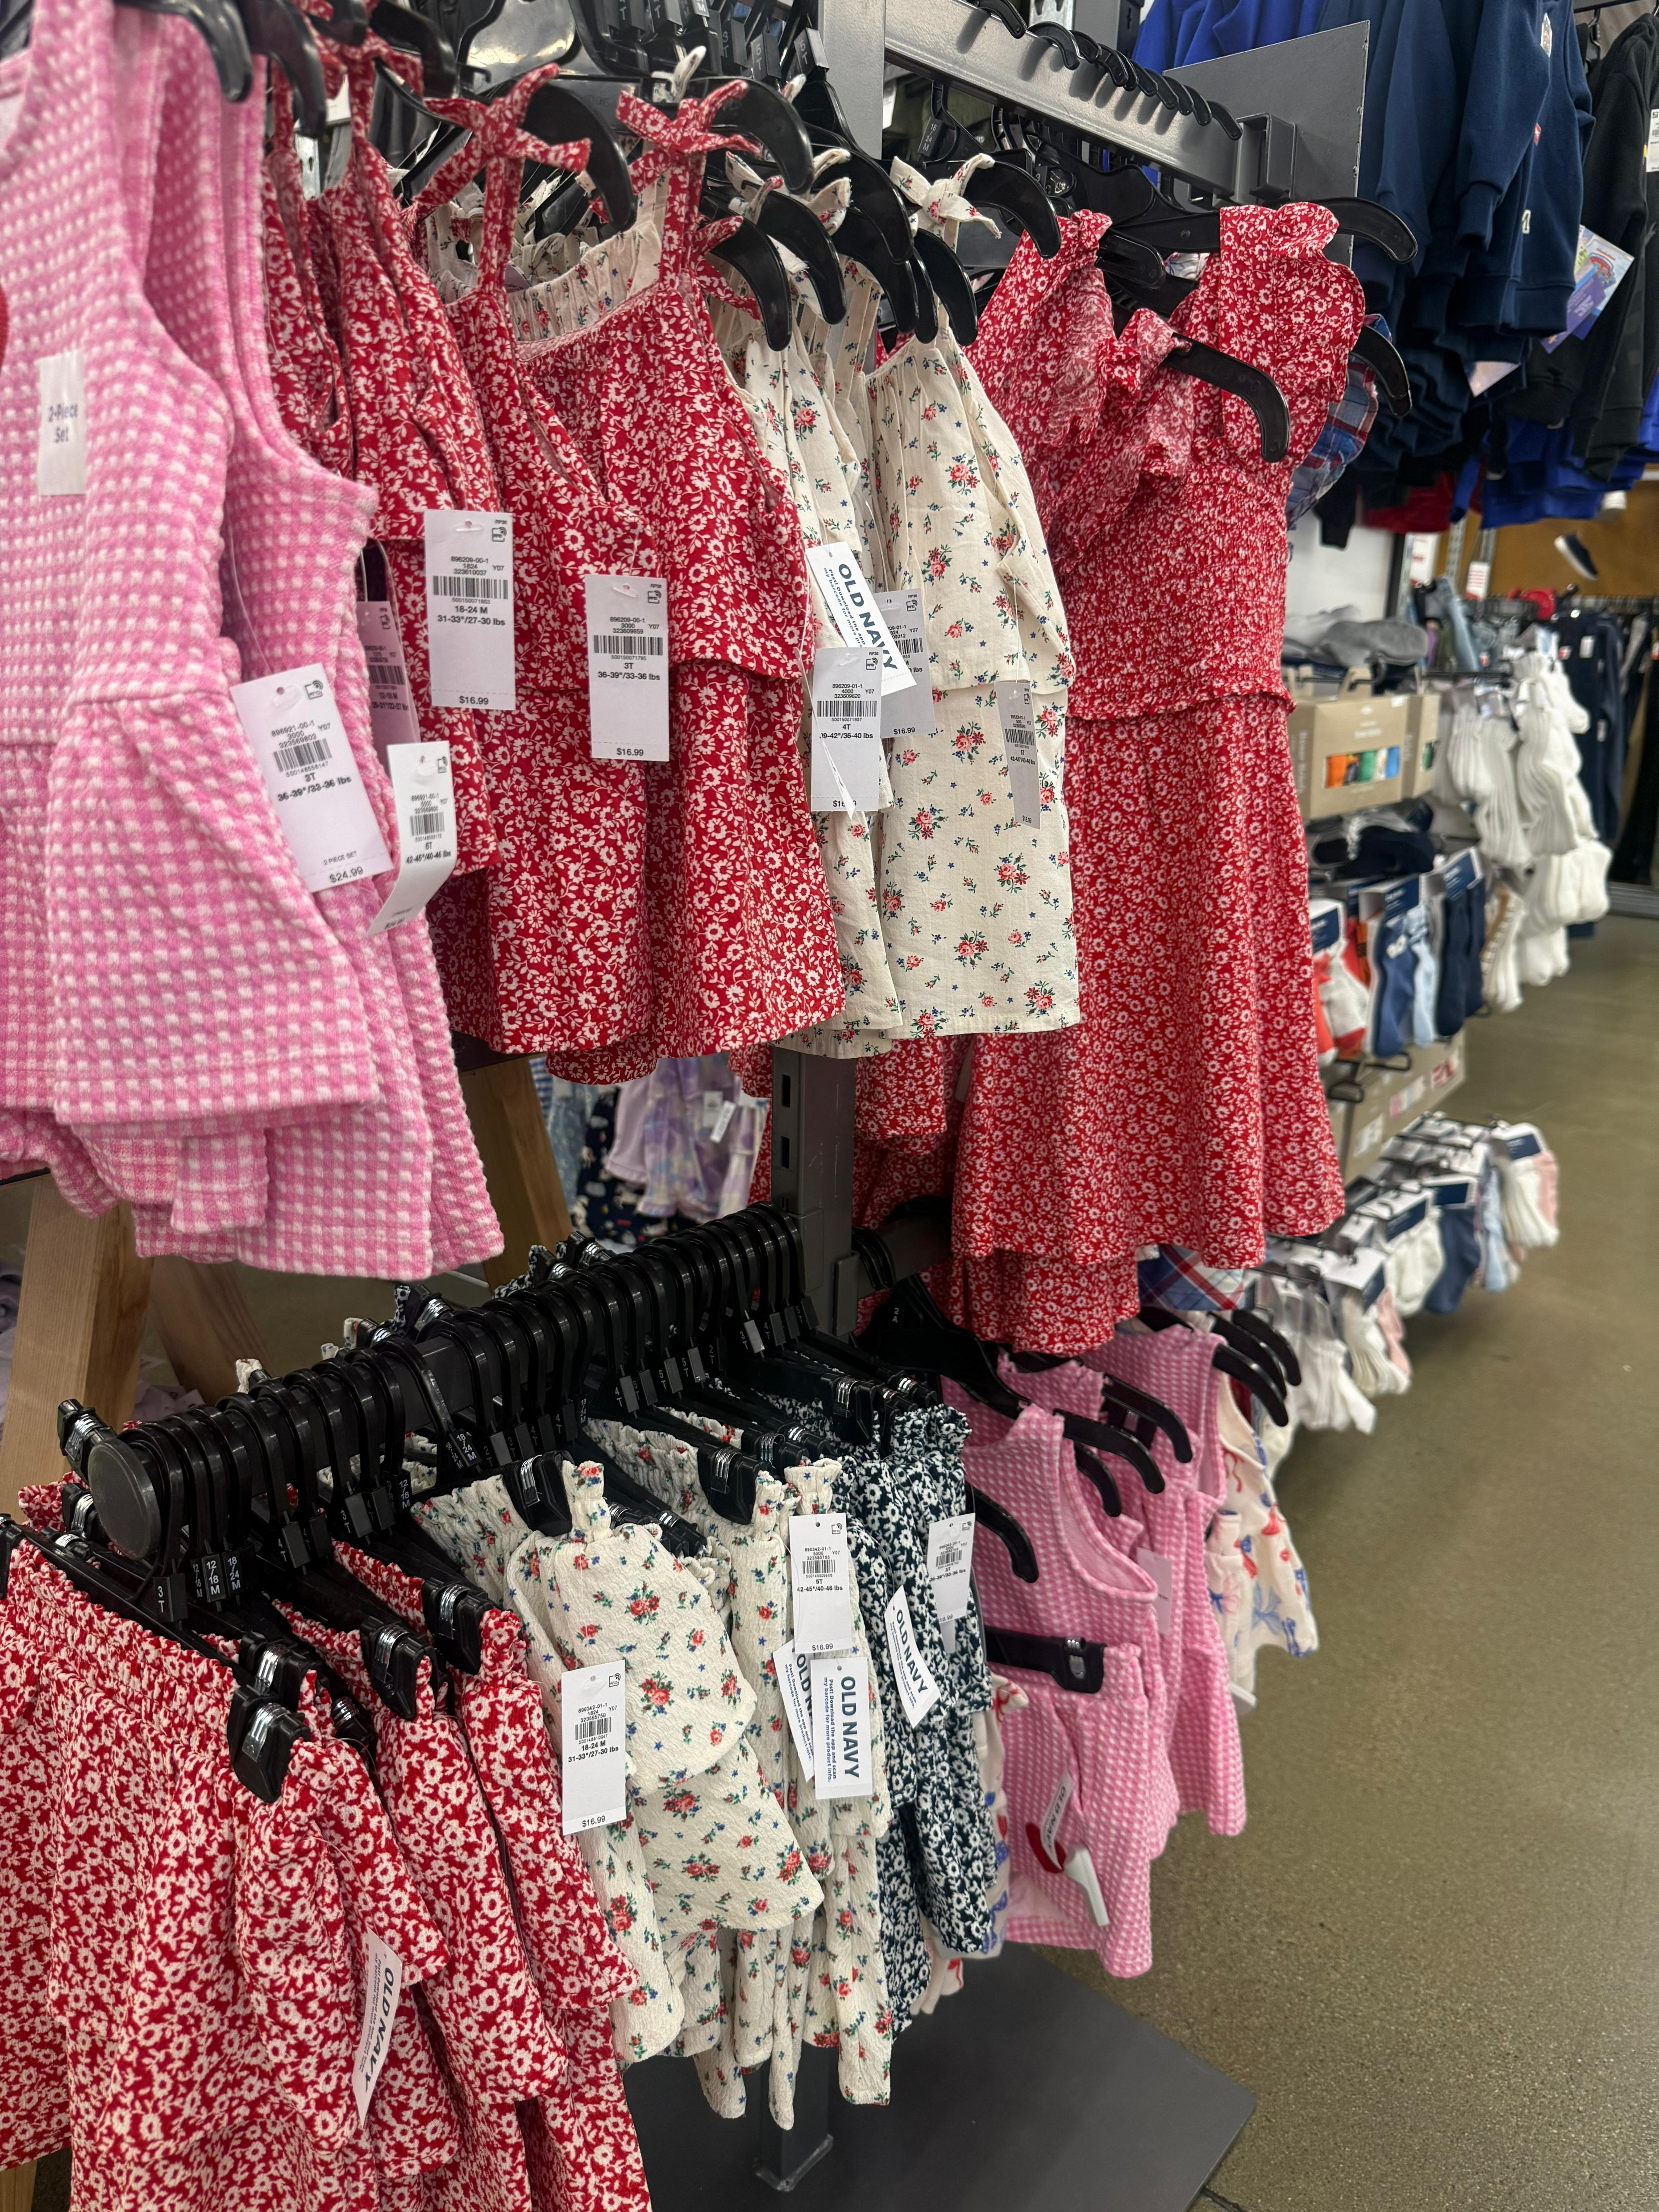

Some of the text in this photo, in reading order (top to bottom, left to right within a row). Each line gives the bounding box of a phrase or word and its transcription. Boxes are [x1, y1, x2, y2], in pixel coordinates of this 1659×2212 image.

[55, 426, 68, 443] Set
[839, 564, 864, 607] OLD
[823, 568, 829, 578] my
[829, 579, 842, 607] barcode
[847, 619, 857, 636] more
[837, 586, 854, 618] Download
[598, 671, 647, 680] 36-39"/33-36
[459, 695, 489, 705] $16.99
[288, 723, 331, 740] 3000 Y07
[893, 727, 915, 735] $16.99
[617, 748, 644, 756] $16.99
[305, 772, 316, 782] 3T
[337, 776, 352, 785] lbs
[328, 855, 346, 863] PIECE
[330, 866, 363, 883] $24.99
[897, 1609, 908, 1645] OLD
[904, 1645, 928, 1693] NAVY
[797, 1653, 811, 1692] OLD
[824, 1677, 828, 1686] my
[792, 1678, 801, 1707] Download
[578, 1703, 607, 1713] 896342-01-1
[785, 1664, 788, 1673] my
[799, 1724, 807, 1745] product
[841, 1676, 859, 1778] OLD NAVY
[568, 1748, 607, 1762] 31-33"/27-30
[582, 1742, 598, 1751] 18-24
[1055, 1786, 1065, 1814] OLD
[582, 1815, 606, 1827] $16.99
[365, 1967, 394, 2093] OLD NAVY
